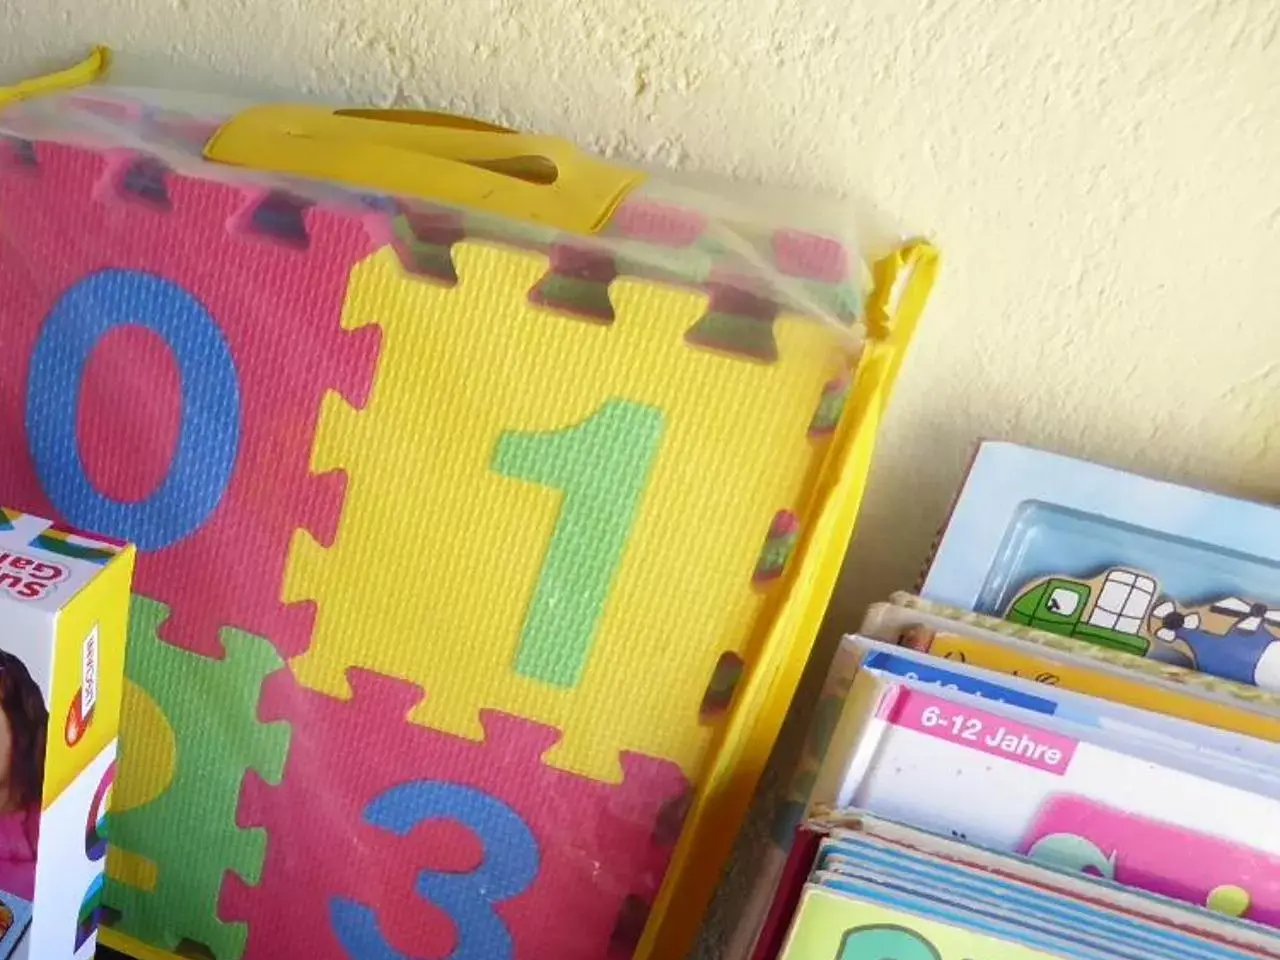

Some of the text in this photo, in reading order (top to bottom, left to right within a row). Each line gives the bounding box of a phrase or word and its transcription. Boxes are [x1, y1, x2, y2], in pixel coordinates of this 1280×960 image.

[488, 396, 664, 689] 1
[920, 706, 1063, 766] 6-12 Jahre
